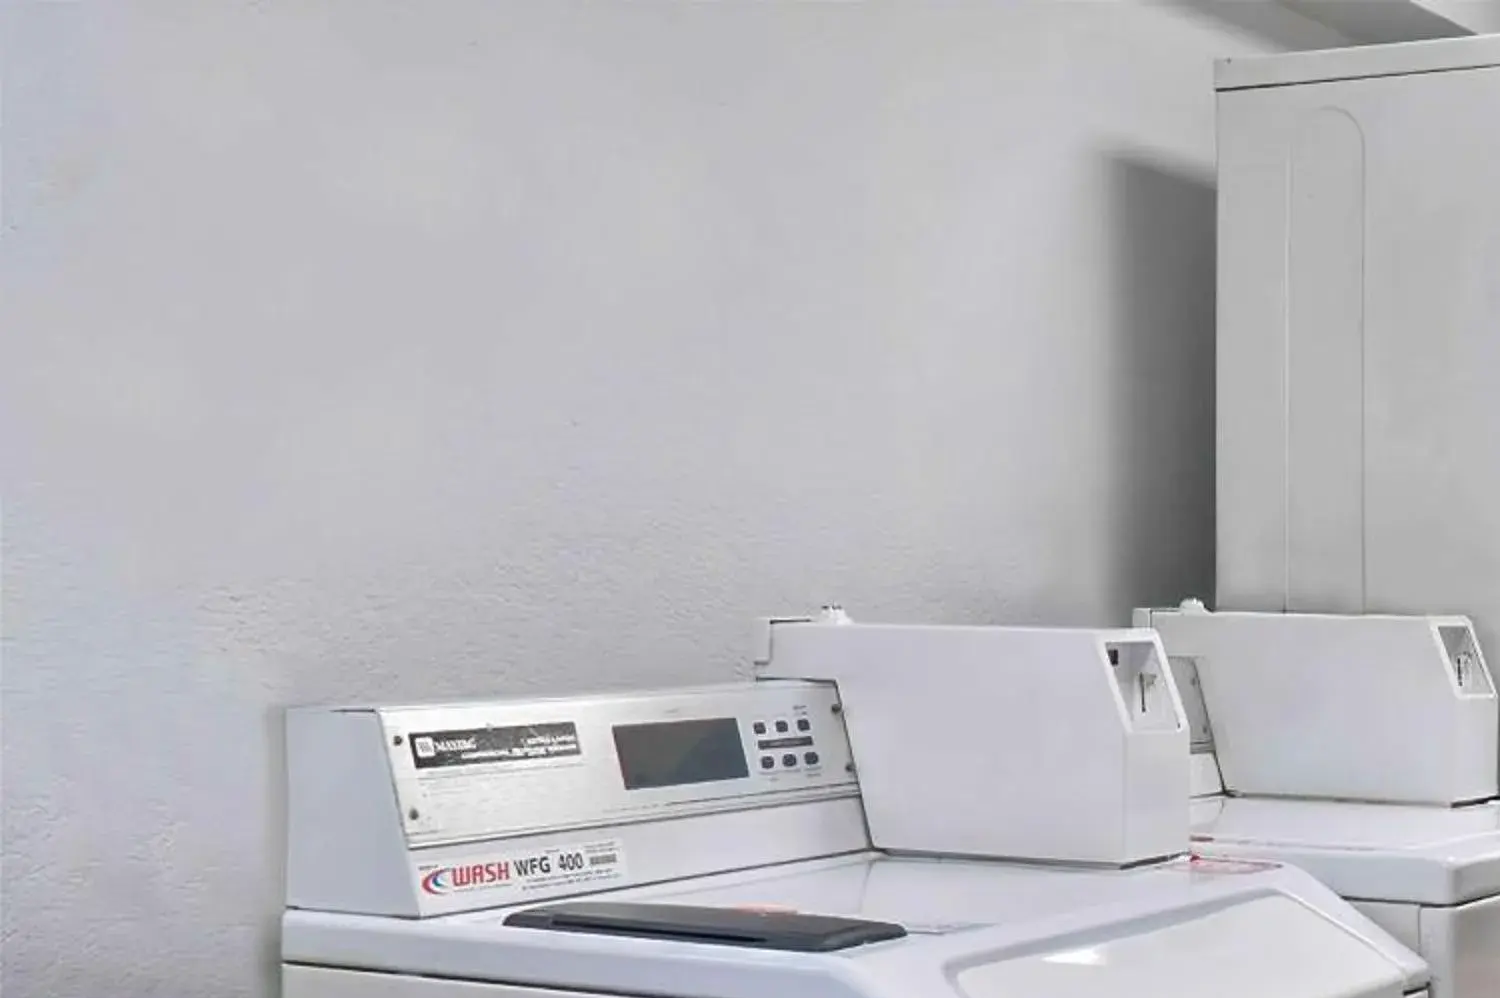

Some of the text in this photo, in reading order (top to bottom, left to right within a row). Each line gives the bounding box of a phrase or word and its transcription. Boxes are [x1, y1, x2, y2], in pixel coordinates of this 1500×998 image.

[451, 861, 510, 887] WASH
[514, 855, 551, 877] WFG
[558, 852, 584, 871] 400
